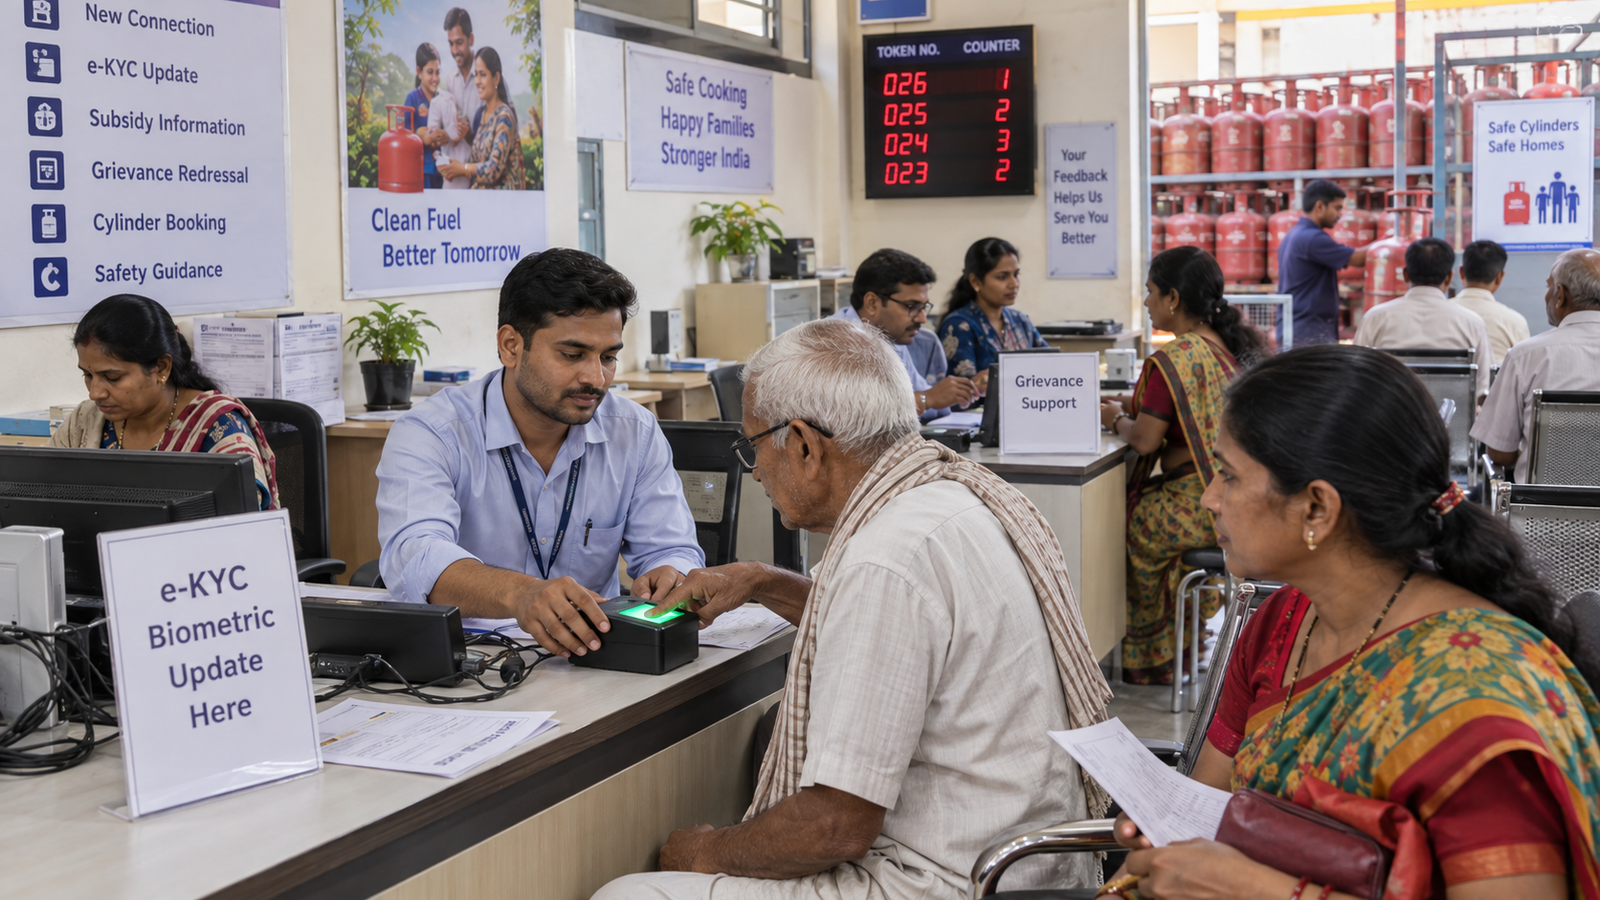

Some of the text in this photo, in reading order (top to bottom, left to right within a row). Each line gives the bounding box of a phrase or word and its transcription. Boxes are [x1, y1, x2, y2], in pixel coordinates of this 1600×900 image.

[86, 3, 215, 37] New Connection
[877, 44, 940, 58] TOKEN NO.
[963, 39, 1020, 53] COUNTER
[87, 57, 199, 84] e-KYC Update
[1002, 68, 1010, 91] 1
[665, 70, 748, 110] Safe Cooking
[883, 72, 927, 96] 026
[884, 102, 928, 126] 025
[995, 98, 1010, 121] 2
[89, 108, 246, 137] Subsidy Information
[661, 106, 756, 139] Happy Families
[1488, 119, 1579, 136] Safe Cylinders
[884, 132, 928, 156] 024
[997, 129, 1010, 152] 3
[1488, 139, 1565, 153] Safe Homes
[661, 142, 751, 172] Stronger India
[1061, 149, 1086, 162] Your
[91, 161, 249, 184] Grievance Redressal
[885, 162, 928, 185] 023
[995, 159, 1010, 182] 2
[1053, 168, 1108, 183] Feedback
[1054, 191, 1103, 206] Helps Us
[93, 212, 227, 236] Cylinder Booking
[371, 207, 462, 233] Clean Fuel
[1054, 211, 1109, 224] Serve You
[1061, 231, 1096, 245] Better
[382, 242, 521, 268] Better Tomorrow
[95, 262, 223, 285] Safety Guidance
[1014, 374, 1084, 388] Grievance
[1021, 396, 1077, 412] Support
[160, 565, 249, 603] e-KYC
[148, 606, 275, 649] Biometric
[168, 652, 264, 692] Update
[189, 697, 253, 728] Here
